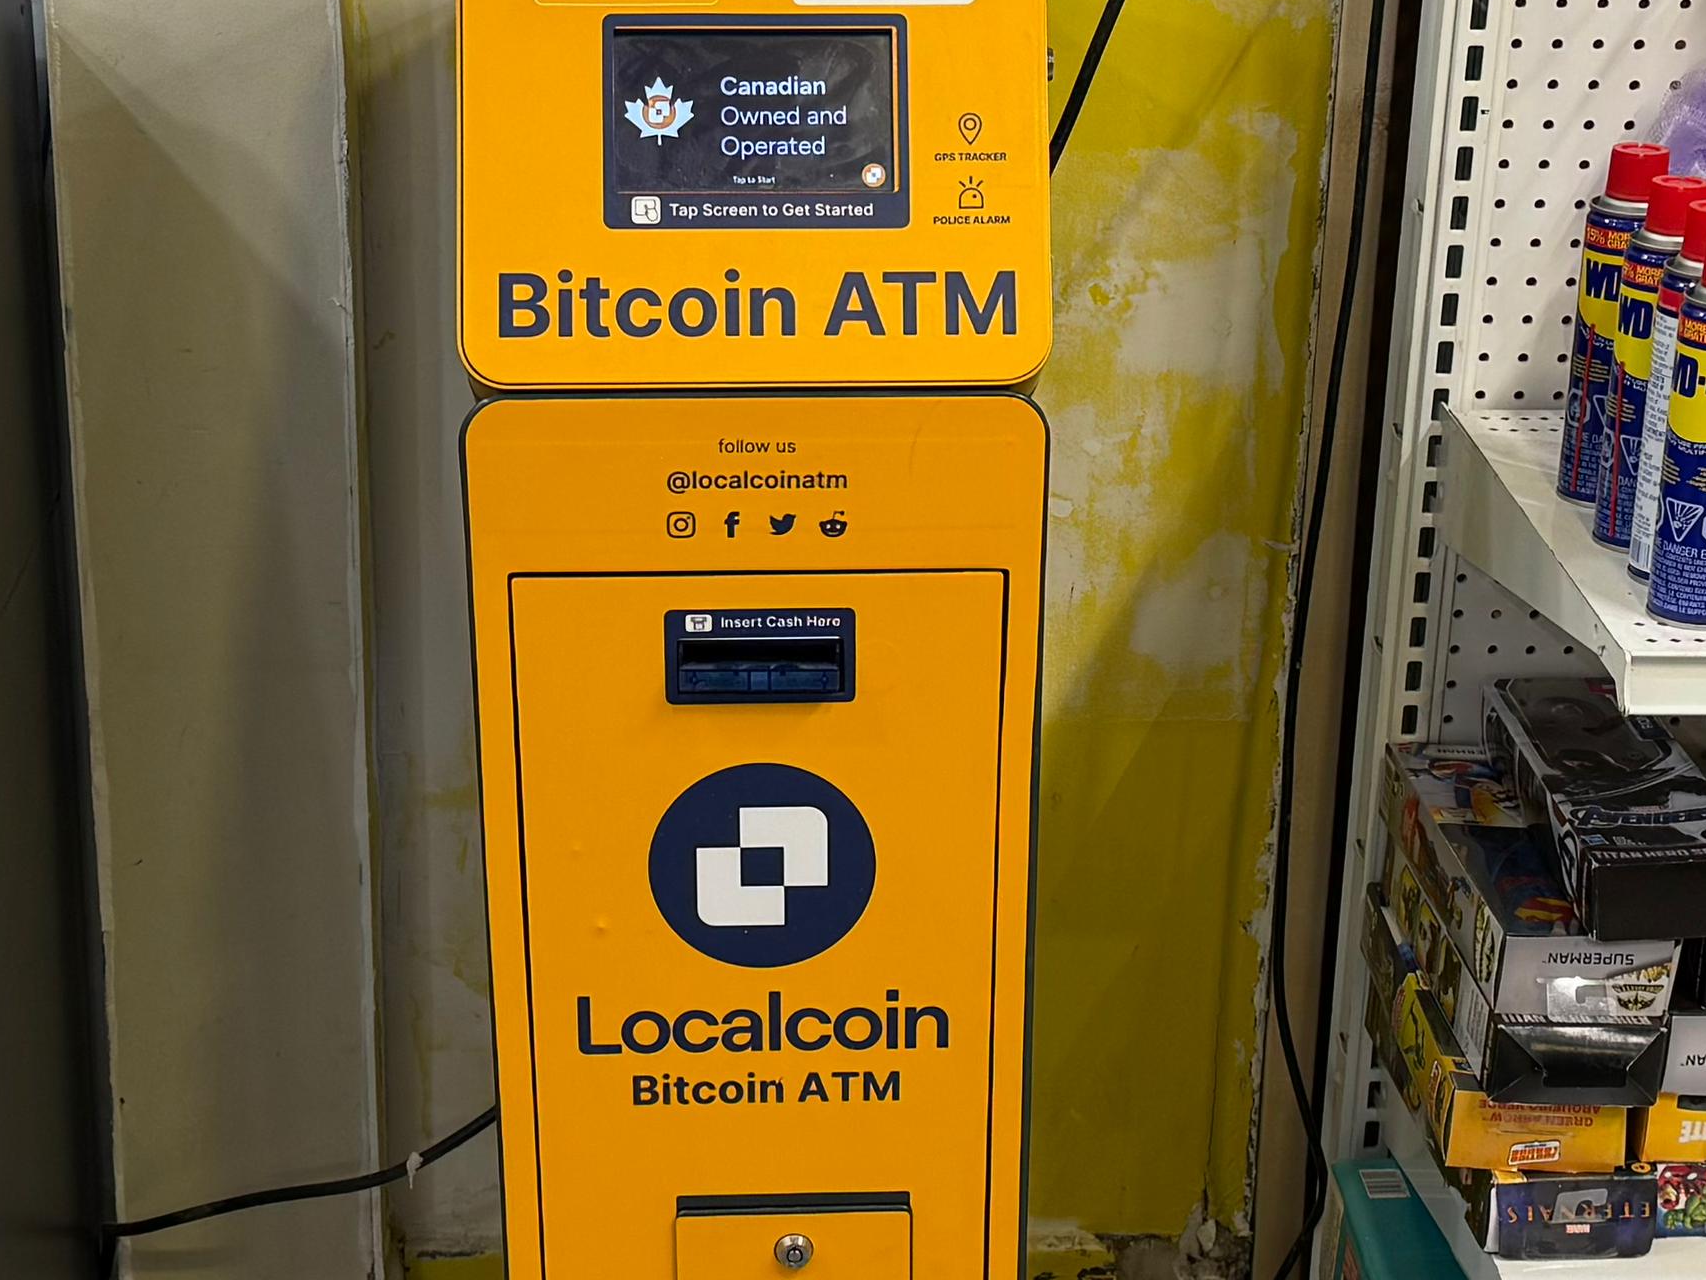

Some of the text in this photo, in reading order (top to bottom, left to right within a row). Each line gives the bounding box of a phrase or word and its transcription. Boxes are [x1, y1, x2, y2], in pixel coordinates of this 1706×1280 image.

[720, 77, 826, 98] Canadian
[720, 106, 846, 127] Owned and
[720, 136, 826, 160] Operated
[934, 153, 1006, 161] GPS TRACKER
[670, 201, 873, 218] Tap Screen to Get Started
[933, 215, 1010, 224] POLICE ALARM
[498, 268, 1017, 339] Bitcoin ATM
[718, 439, 796, 454] follow us
[667, 470, 848, 493] @localcoinatm
[720, 615, 841, 629] Insert Cash Here
[1594, 849, 1644, 859] TITAN
[1646, 848, 1688, 858] HERO
[1548, 952, 1634, 965] SUPERMAN
[577, 990, 949, 1056] Localcoin
[632, 1071, 901, 1106] Bitcoin ATM
[1506, 1202, 1651, 1223] ETERNALS
